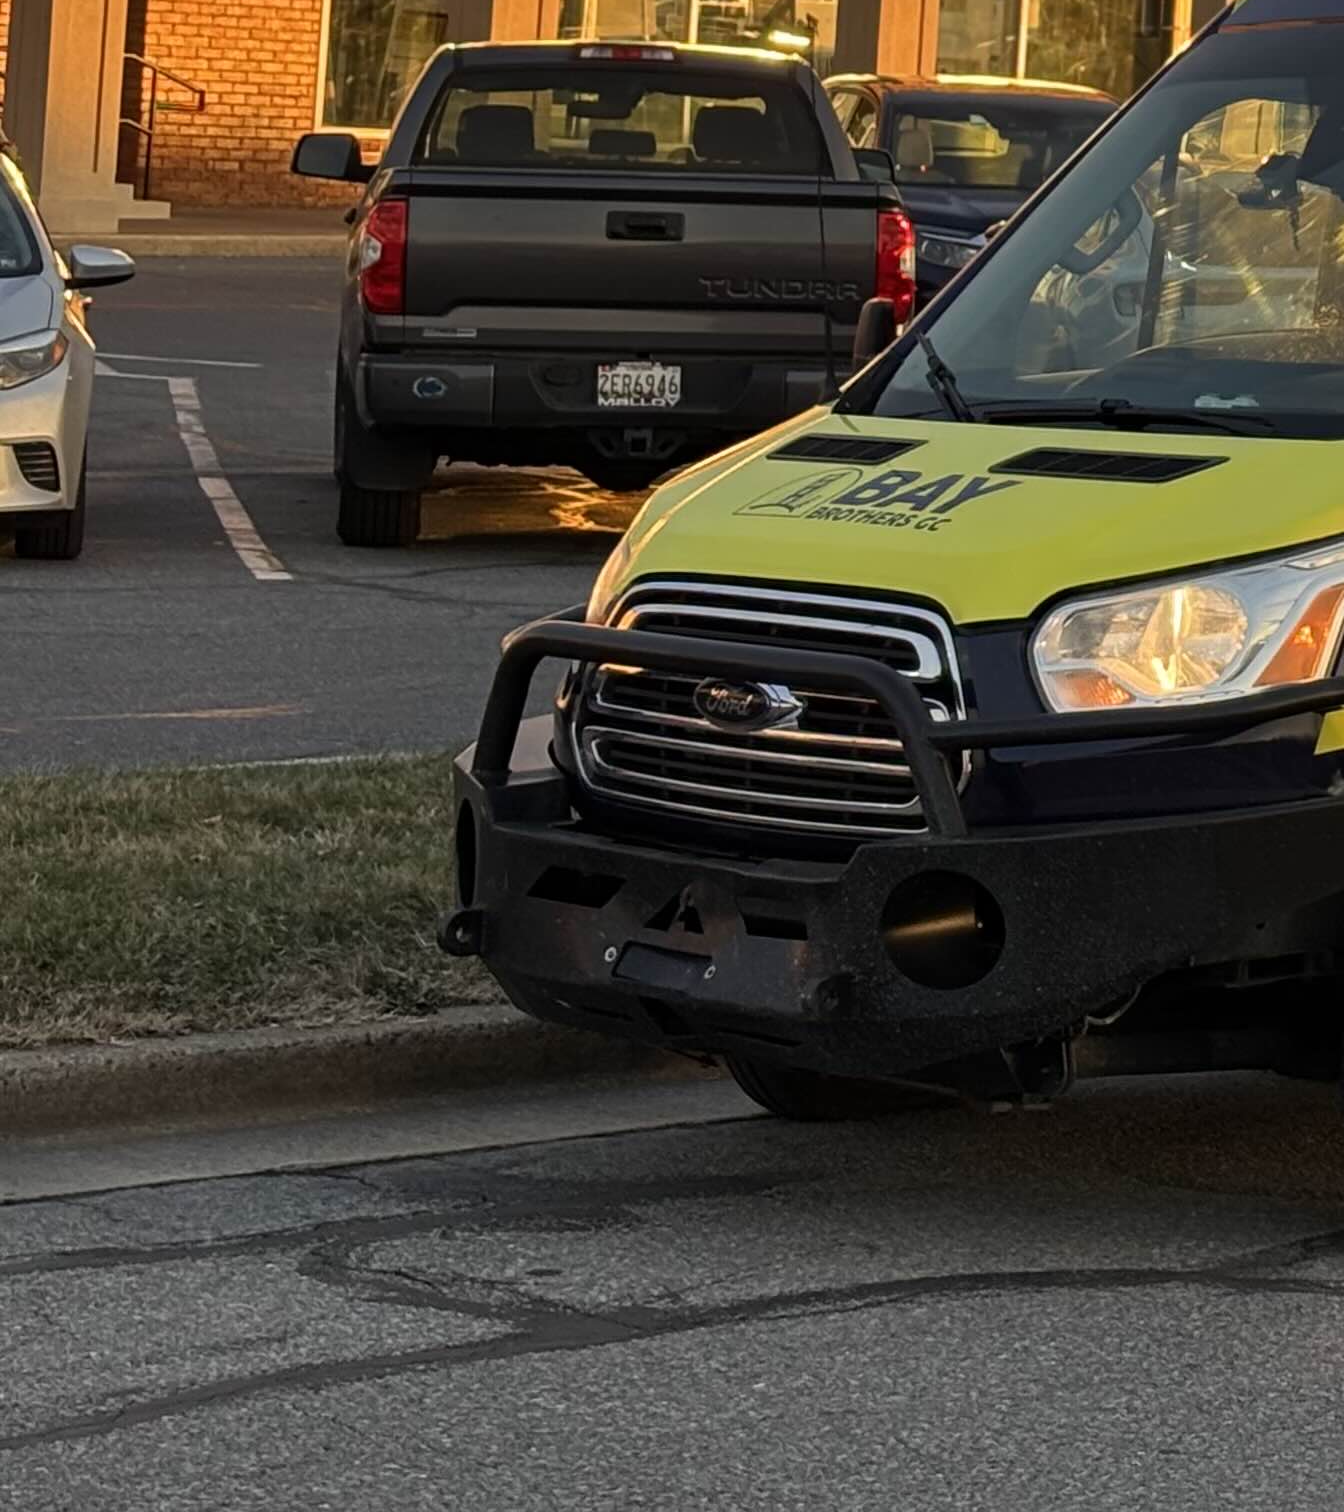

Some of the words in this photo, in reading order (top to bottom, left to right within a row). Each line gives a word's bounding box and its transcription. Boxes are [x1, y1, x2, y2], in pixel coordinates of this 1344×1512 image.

[698, 277, 862, 301] TUNDRA
[830, 469, 1023, 514] BAY
[806, 506, 914, 528] BROTHERS
[914, 516, 952, 531] GC
